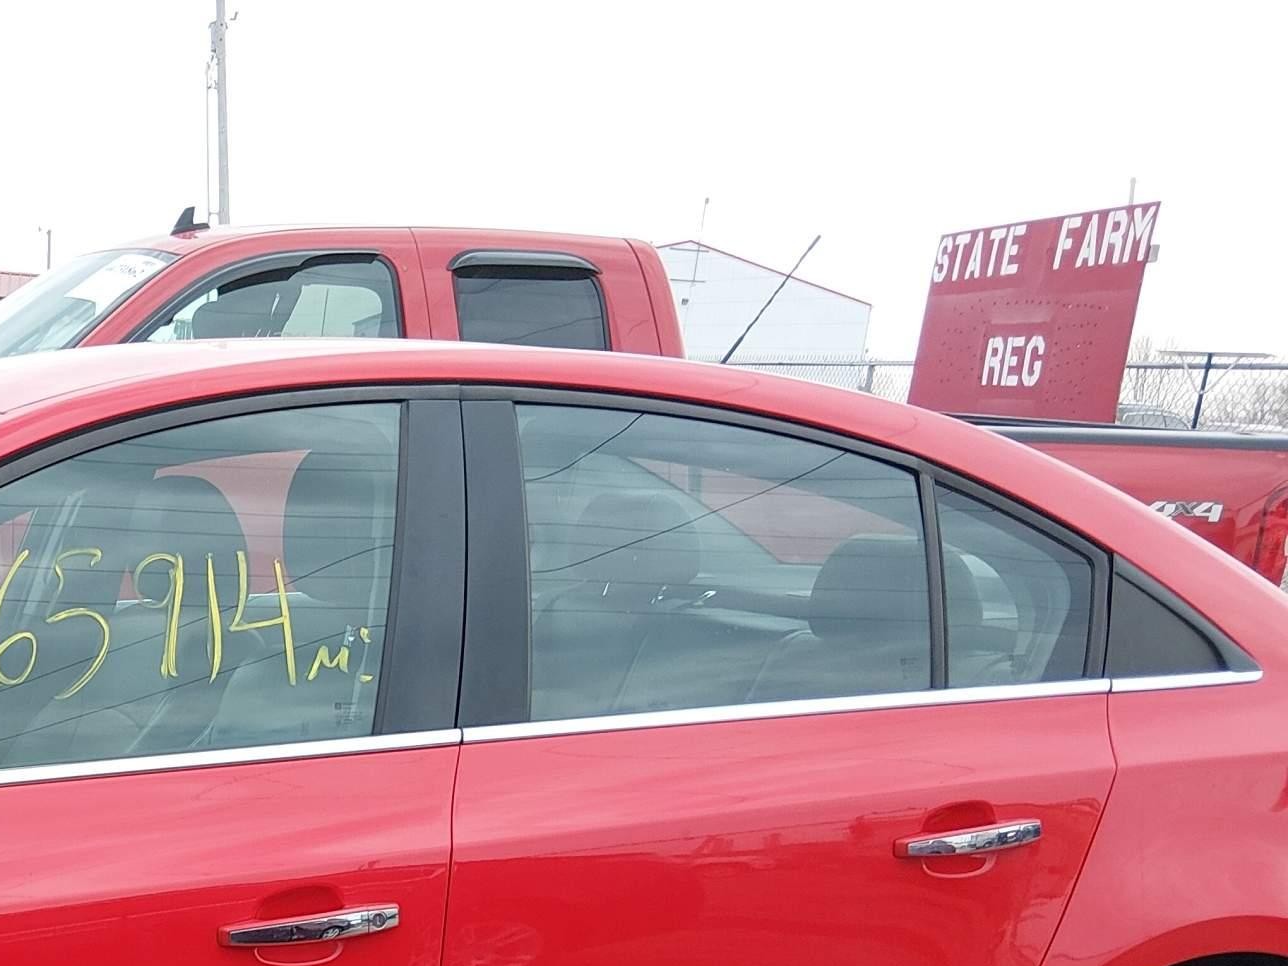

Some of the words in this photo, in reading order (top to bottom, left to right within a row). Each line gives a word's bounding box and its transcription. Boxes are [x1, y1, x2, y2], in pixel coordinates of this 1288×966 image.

[932, 224, 1027, 283] STATE
[1052, 205, 1157, 270] FARM
[981, 335, 1046, 387] REG
